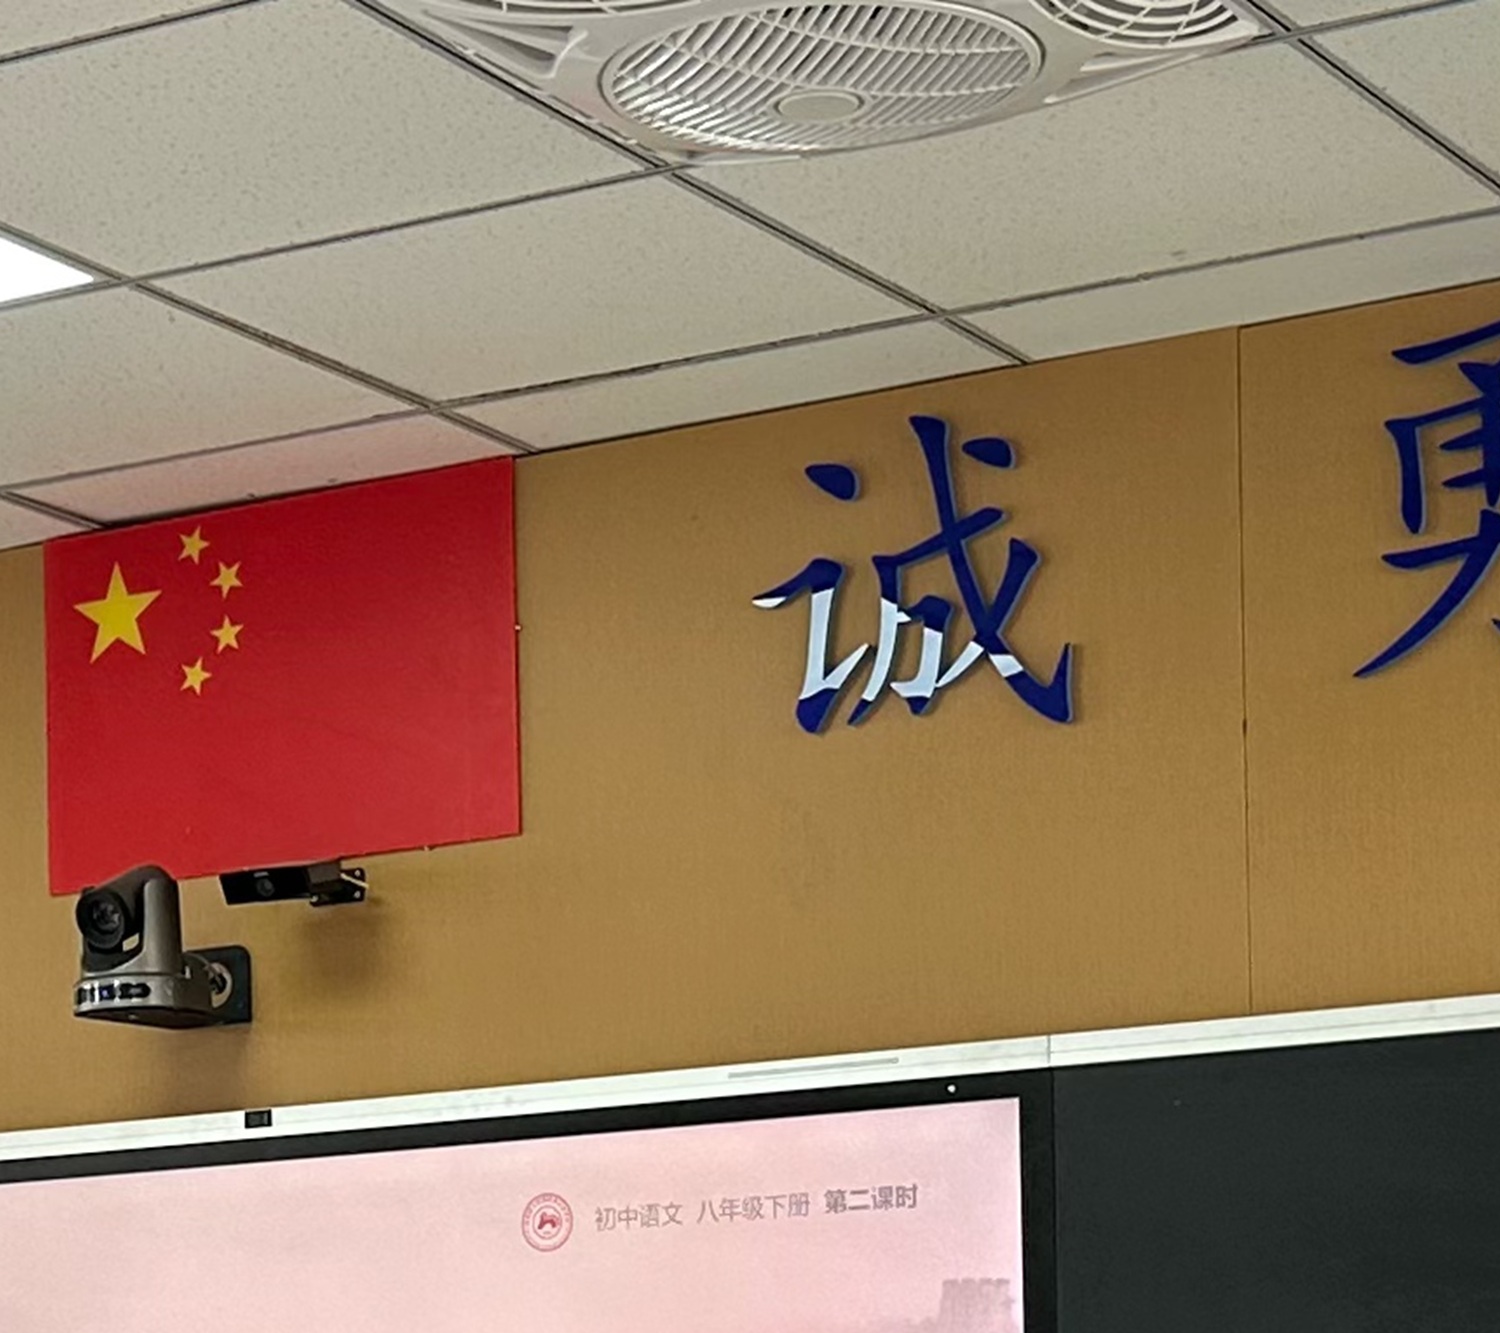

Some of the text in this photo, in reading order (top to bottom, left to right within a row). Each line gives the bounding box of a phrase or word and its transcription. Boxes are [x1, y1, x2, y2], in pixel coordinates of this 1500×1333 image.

[752, 414, 1073, 734] 诚
[595, 1201, 684, 1232] 初中语文
[697, 1192, 811, 1223] 八年级下册
[824, 1183, 918, 1214] 第二课时
